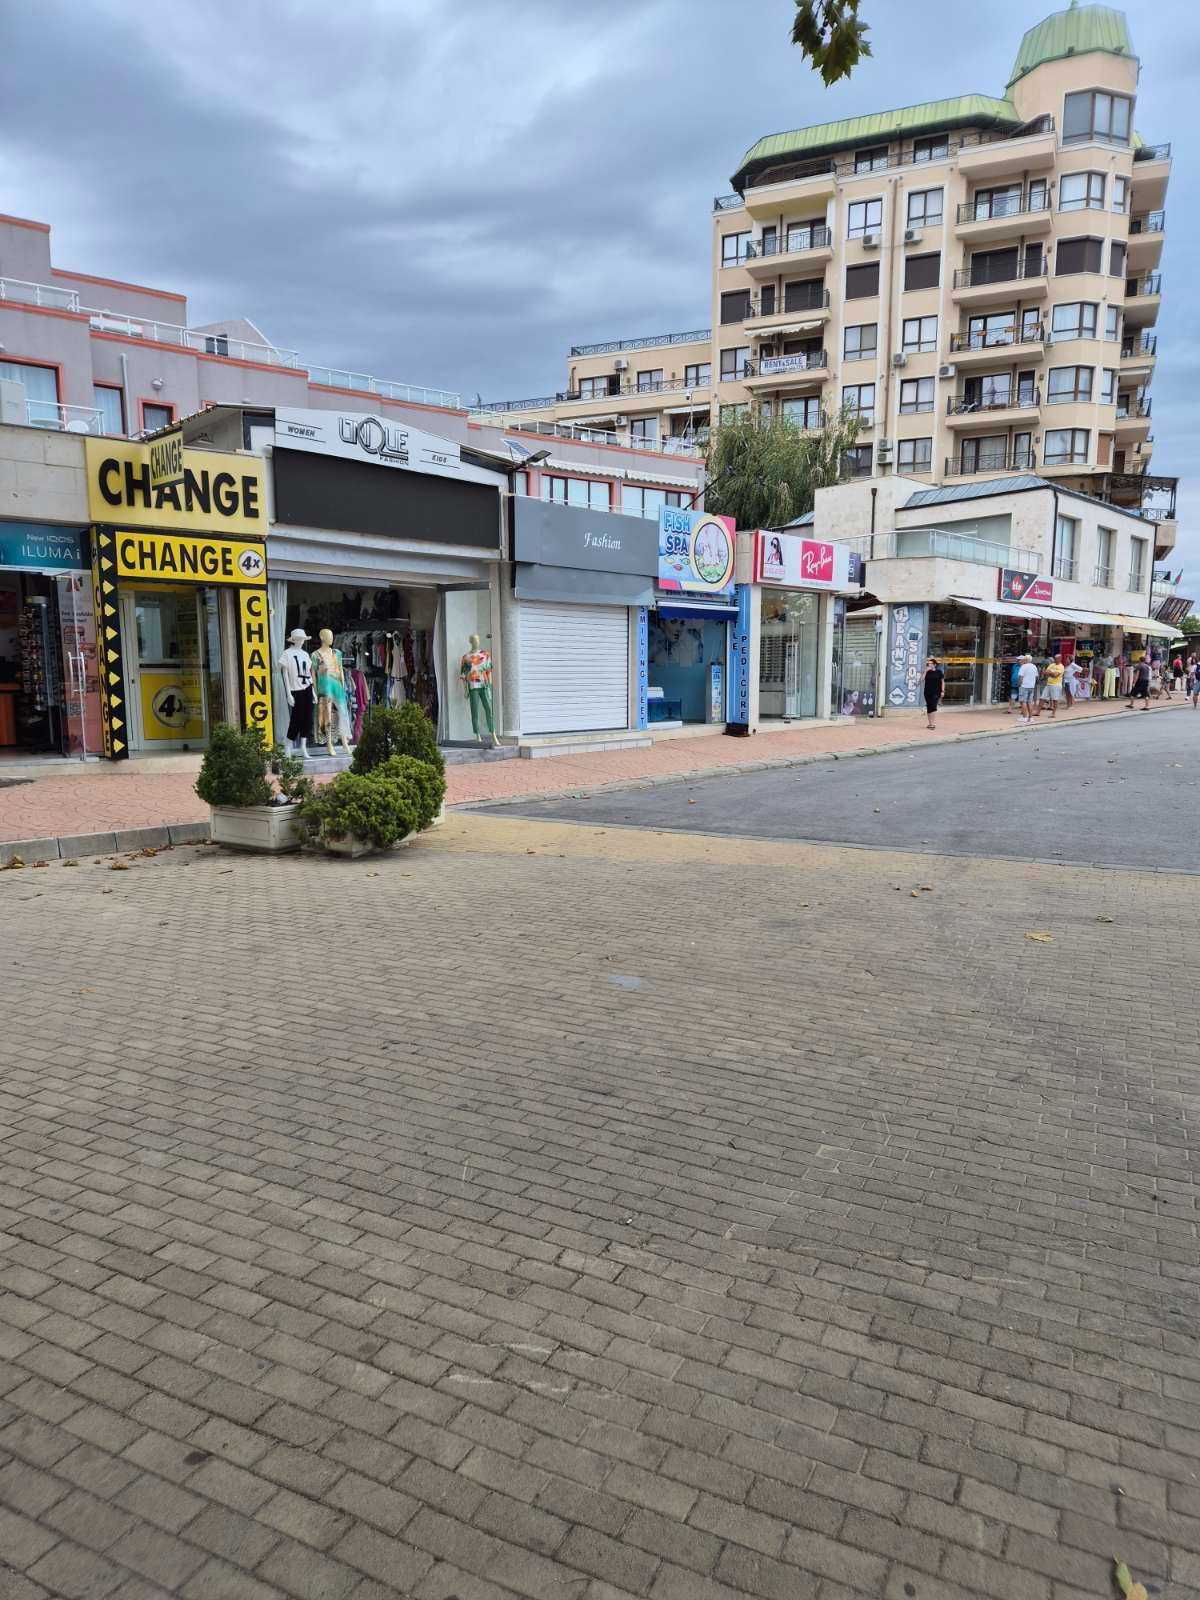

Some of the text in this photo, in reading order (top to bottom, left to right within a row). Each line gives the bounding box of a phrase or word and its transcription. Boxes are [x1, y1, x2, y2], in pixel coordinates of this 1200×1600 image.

[288, 425, 315, 437] WOMEN
[151, 438, 183, 480] CHANGE
[98, 458, 260, 518] CHANGE
[663, 510, 691, 535] FISH
[22, 544, 73, 560] ILUMA
[584, 532, 622, 551] Fashion
[666, 535, 690, 556] SPA
[120, 538, 234, 577] CHANGE
[907, 641, 919, 702] SHOES
